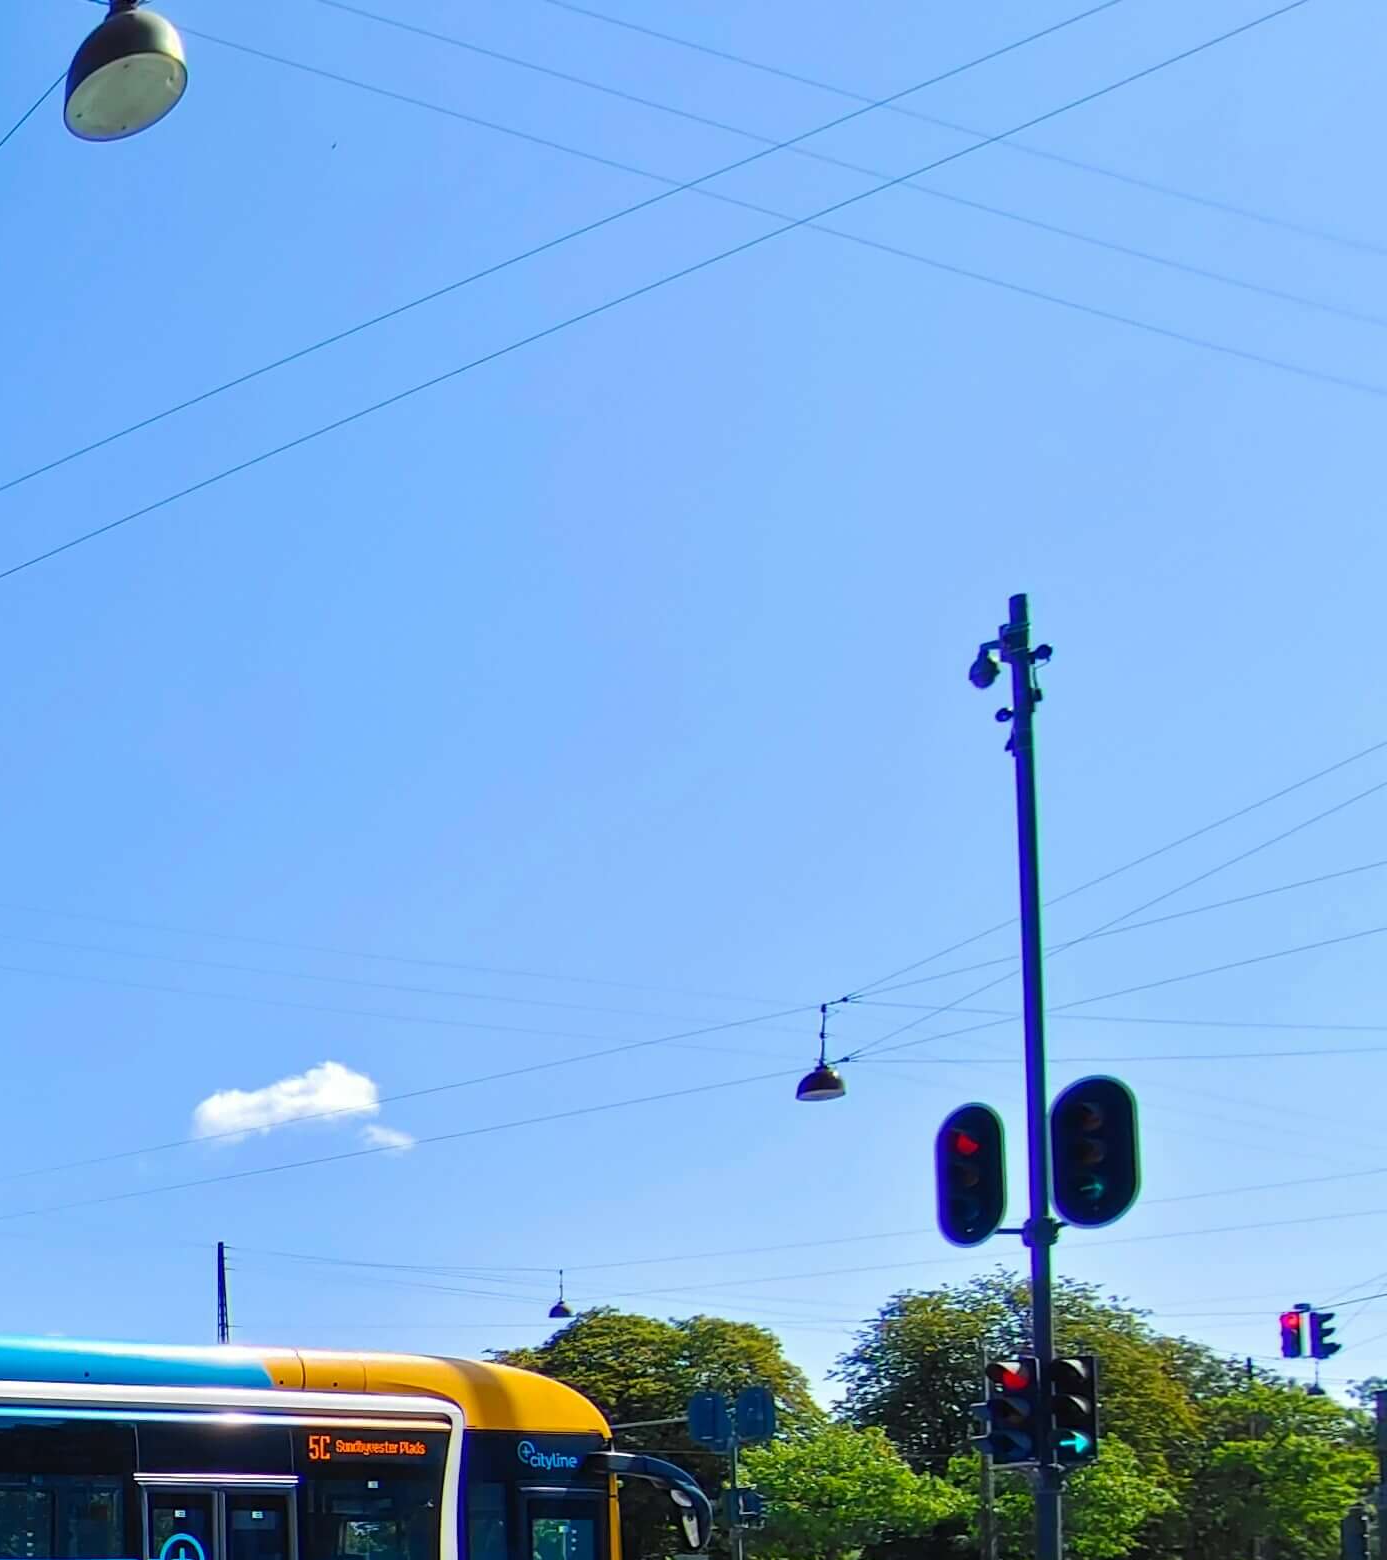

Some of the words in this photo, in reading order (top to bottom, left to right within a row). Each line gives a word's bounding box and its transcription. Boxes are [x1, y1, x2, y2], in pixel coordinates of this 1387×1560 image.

[309, 1435, 331, 1460] 5C
[335, 1439, 398, 1456] Sundbyvester
[399, 1441, 426, 1455] Plads
[530, 1452, 578, 1470] cityline
